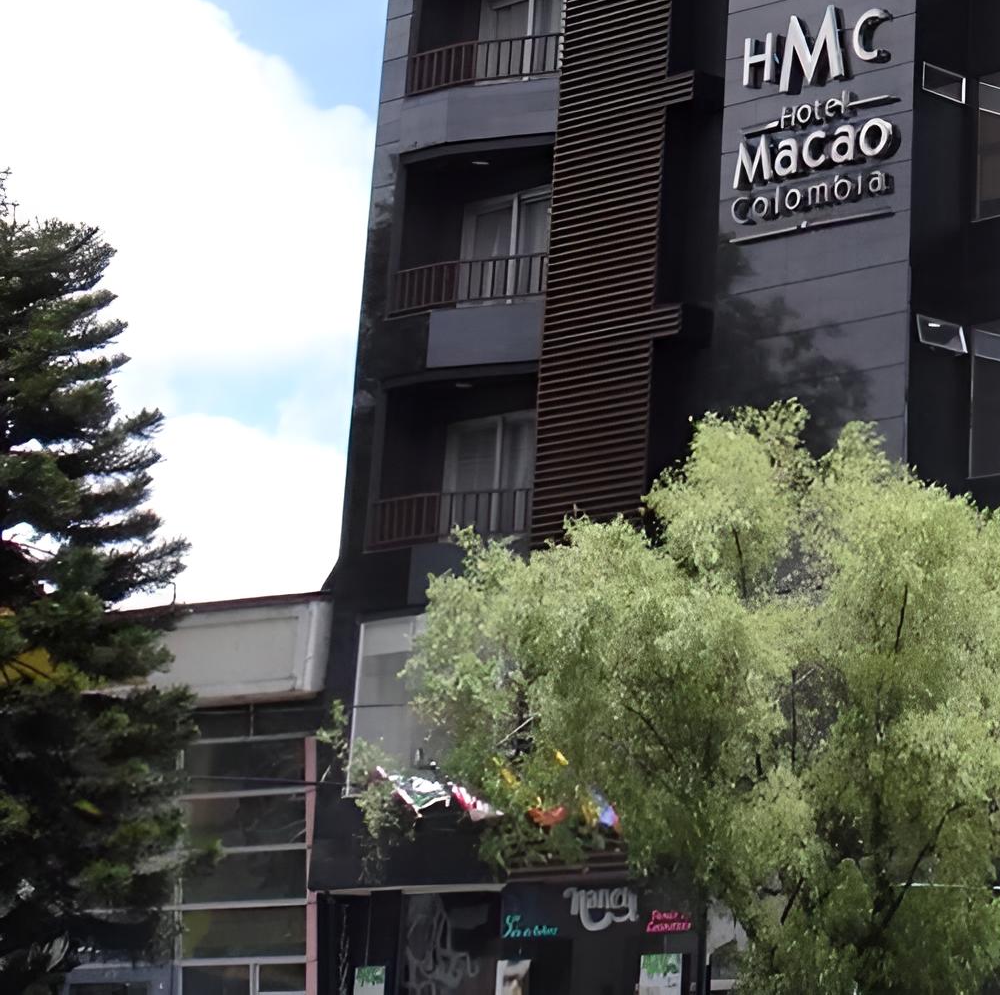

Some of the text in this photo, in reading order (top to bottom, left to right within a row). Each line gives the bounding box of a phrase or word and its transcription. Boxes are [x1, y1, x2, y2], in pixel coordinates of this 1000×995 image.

[742, 4, 893, 94] HMC
[779, 89, 853, 129] Hotel
[733, 117, 894, 189] Macao
[731, 170, 890, 224] Colombia
